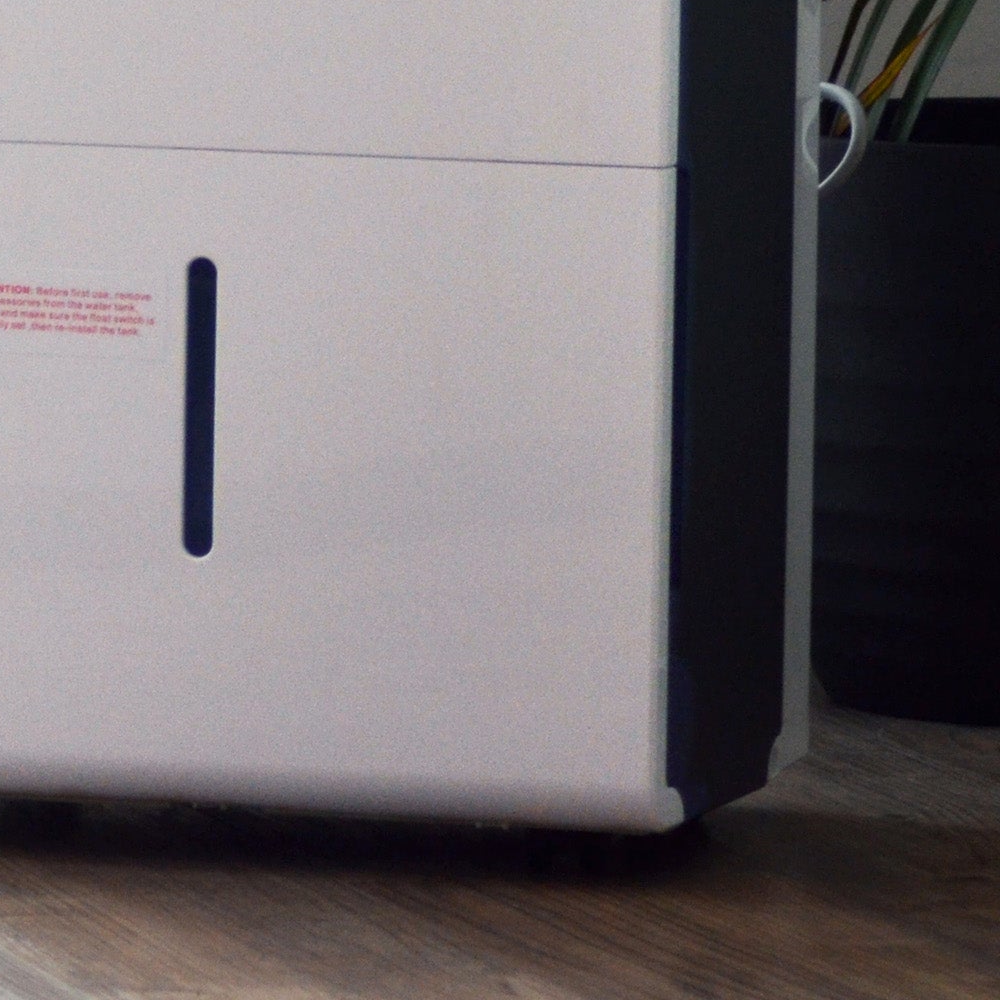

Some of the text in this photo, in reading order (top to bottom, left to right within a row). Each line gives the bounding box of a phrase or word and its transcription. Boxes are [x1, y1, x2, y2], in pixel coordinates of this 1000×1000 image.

[36, 286, 69, 297] Before
[43, 299, 65, 308] from
[67, 300, 83, 310] the
[86, 303, 112, 312] water
[0, 309, 18, 318] and
[20, 310, 46, 319] make
[49, 312, 70, 321] sure
[72, 312, 88, 322] the
[114, 315, 144, 325] switch
[100, 325, 116, 335] the
